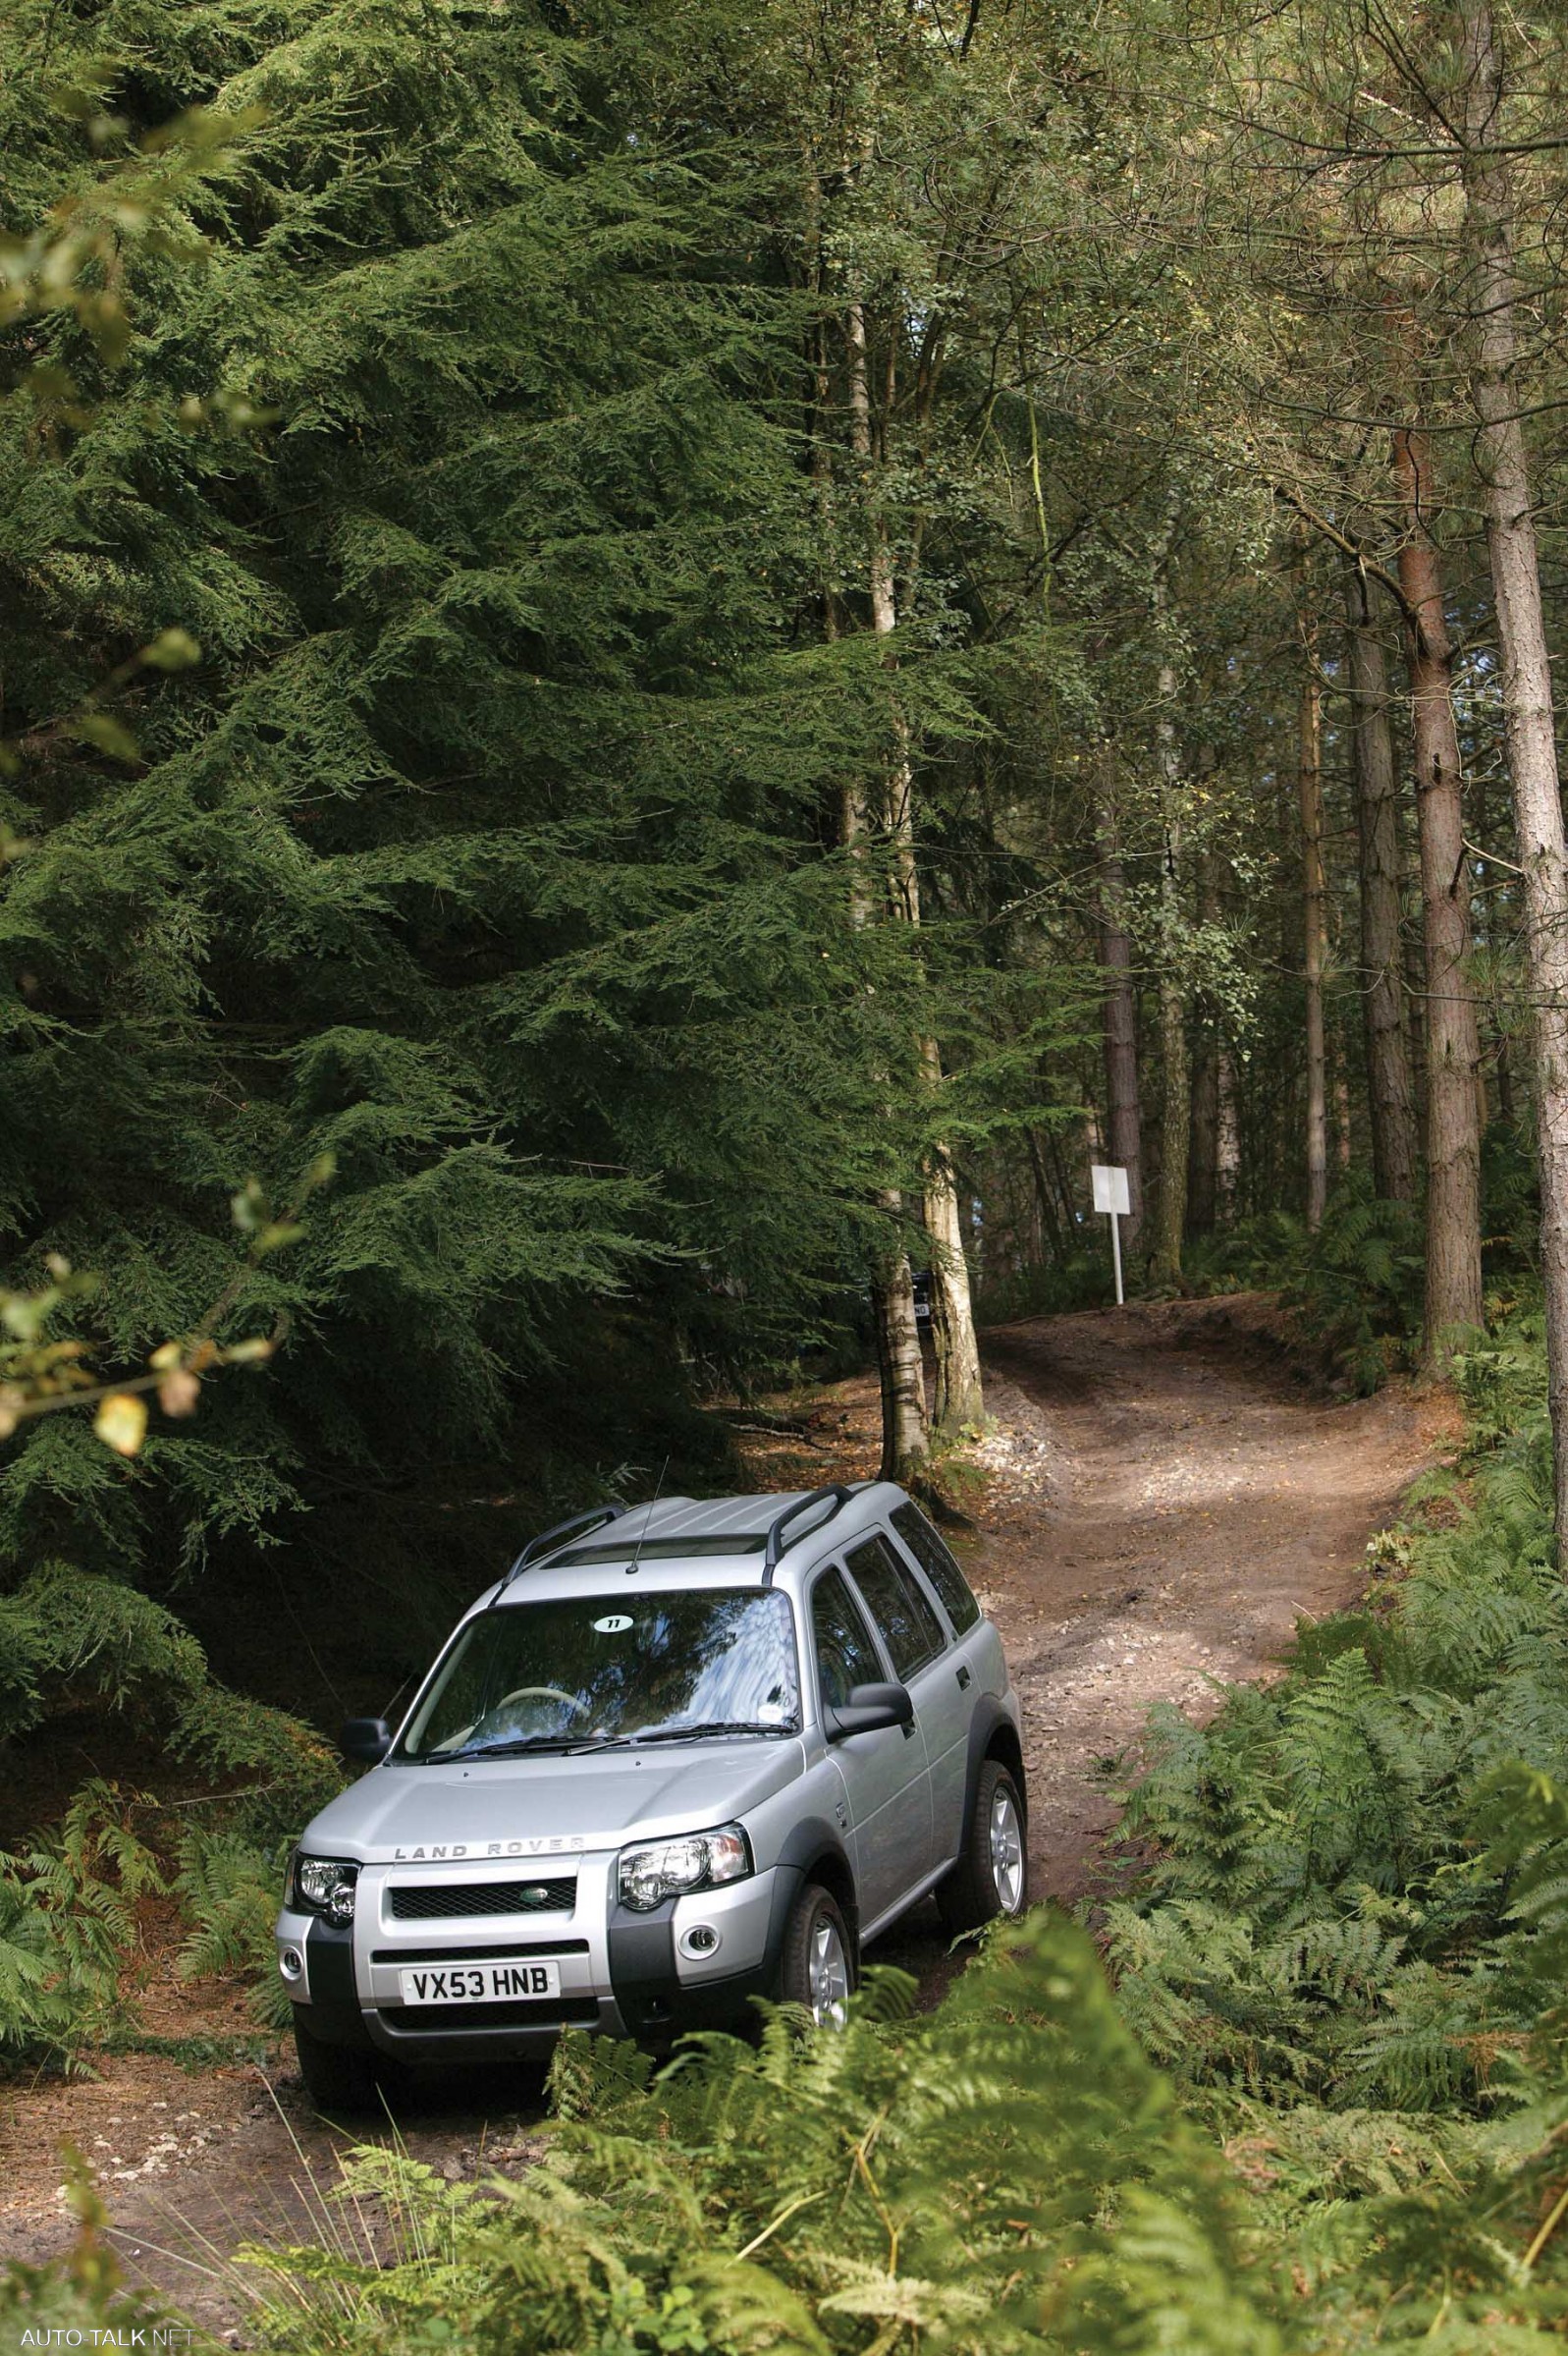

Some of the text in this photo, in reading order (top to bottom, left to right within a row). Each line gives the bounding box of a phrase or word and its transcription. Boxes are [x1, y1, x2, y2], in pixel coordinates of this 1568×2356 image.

[394, 1836, 585, 1860] LAND ROVER
[412, 1967, 549, 2000] VX53 HNB
